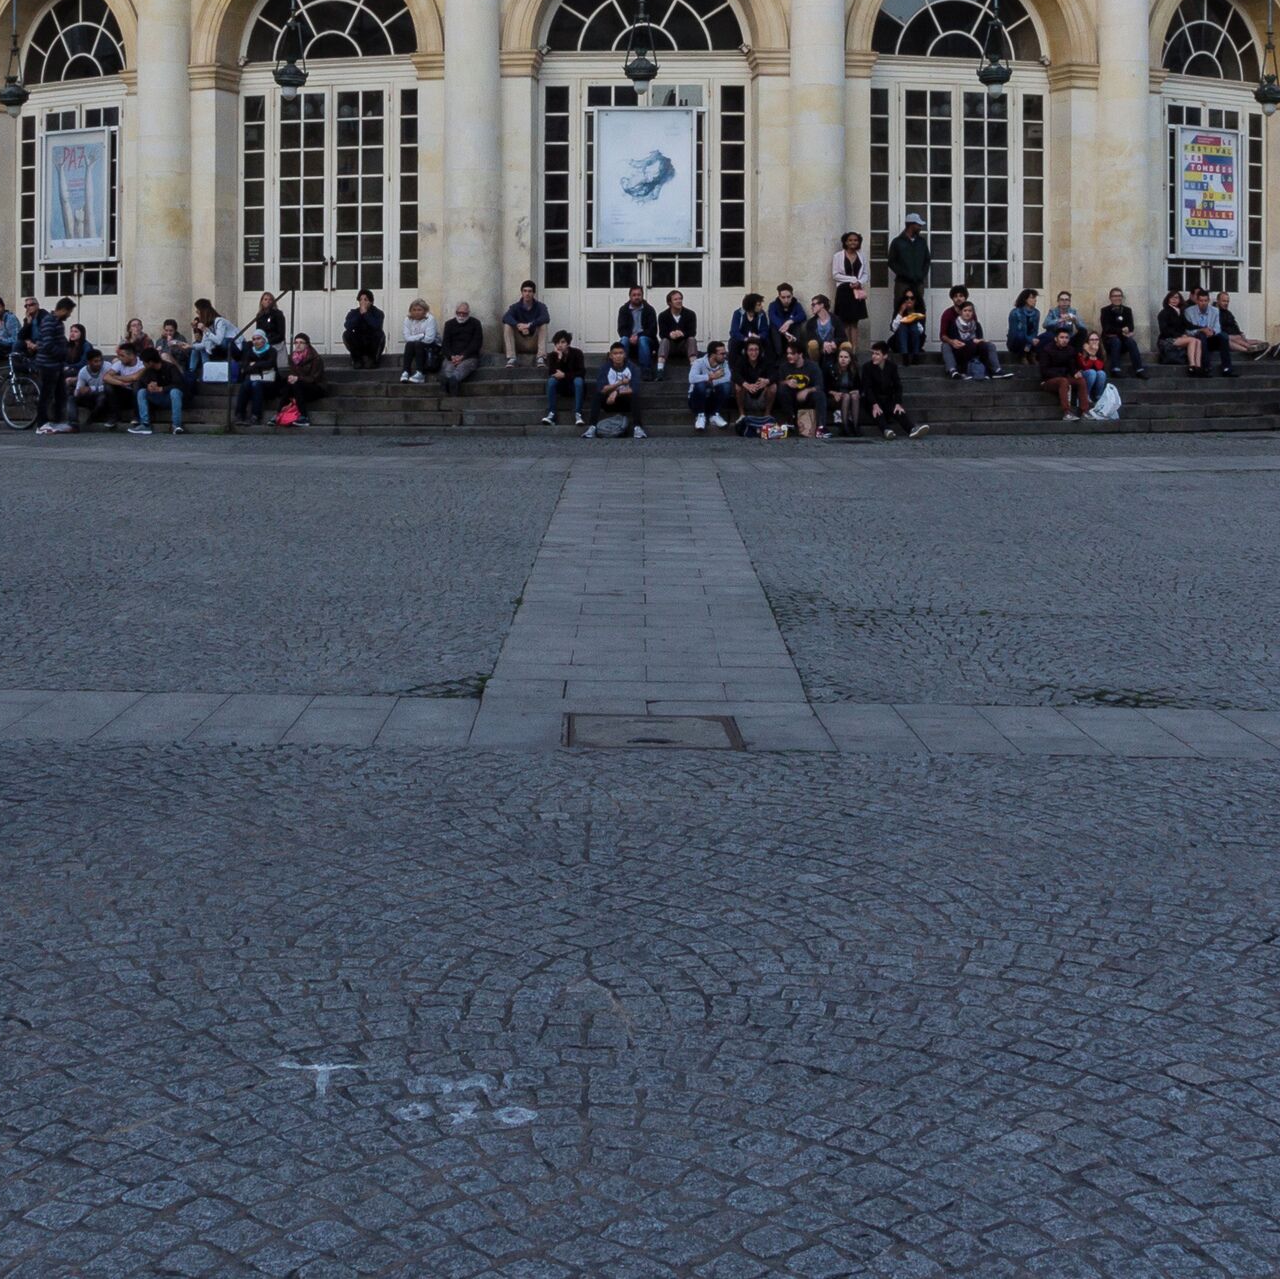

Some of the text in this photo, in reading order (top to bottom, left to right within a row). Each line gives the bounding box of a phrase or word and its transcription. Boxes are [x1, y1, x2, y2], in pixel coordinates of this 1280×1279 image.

[1184, 144, 1233, 155] FESTIVAL
[1190, 163, 1233, 173] TOMBÉES
[1184, 182, 1208, 190] NUIT
[1191, 209, 1233, 219] JUILLET
